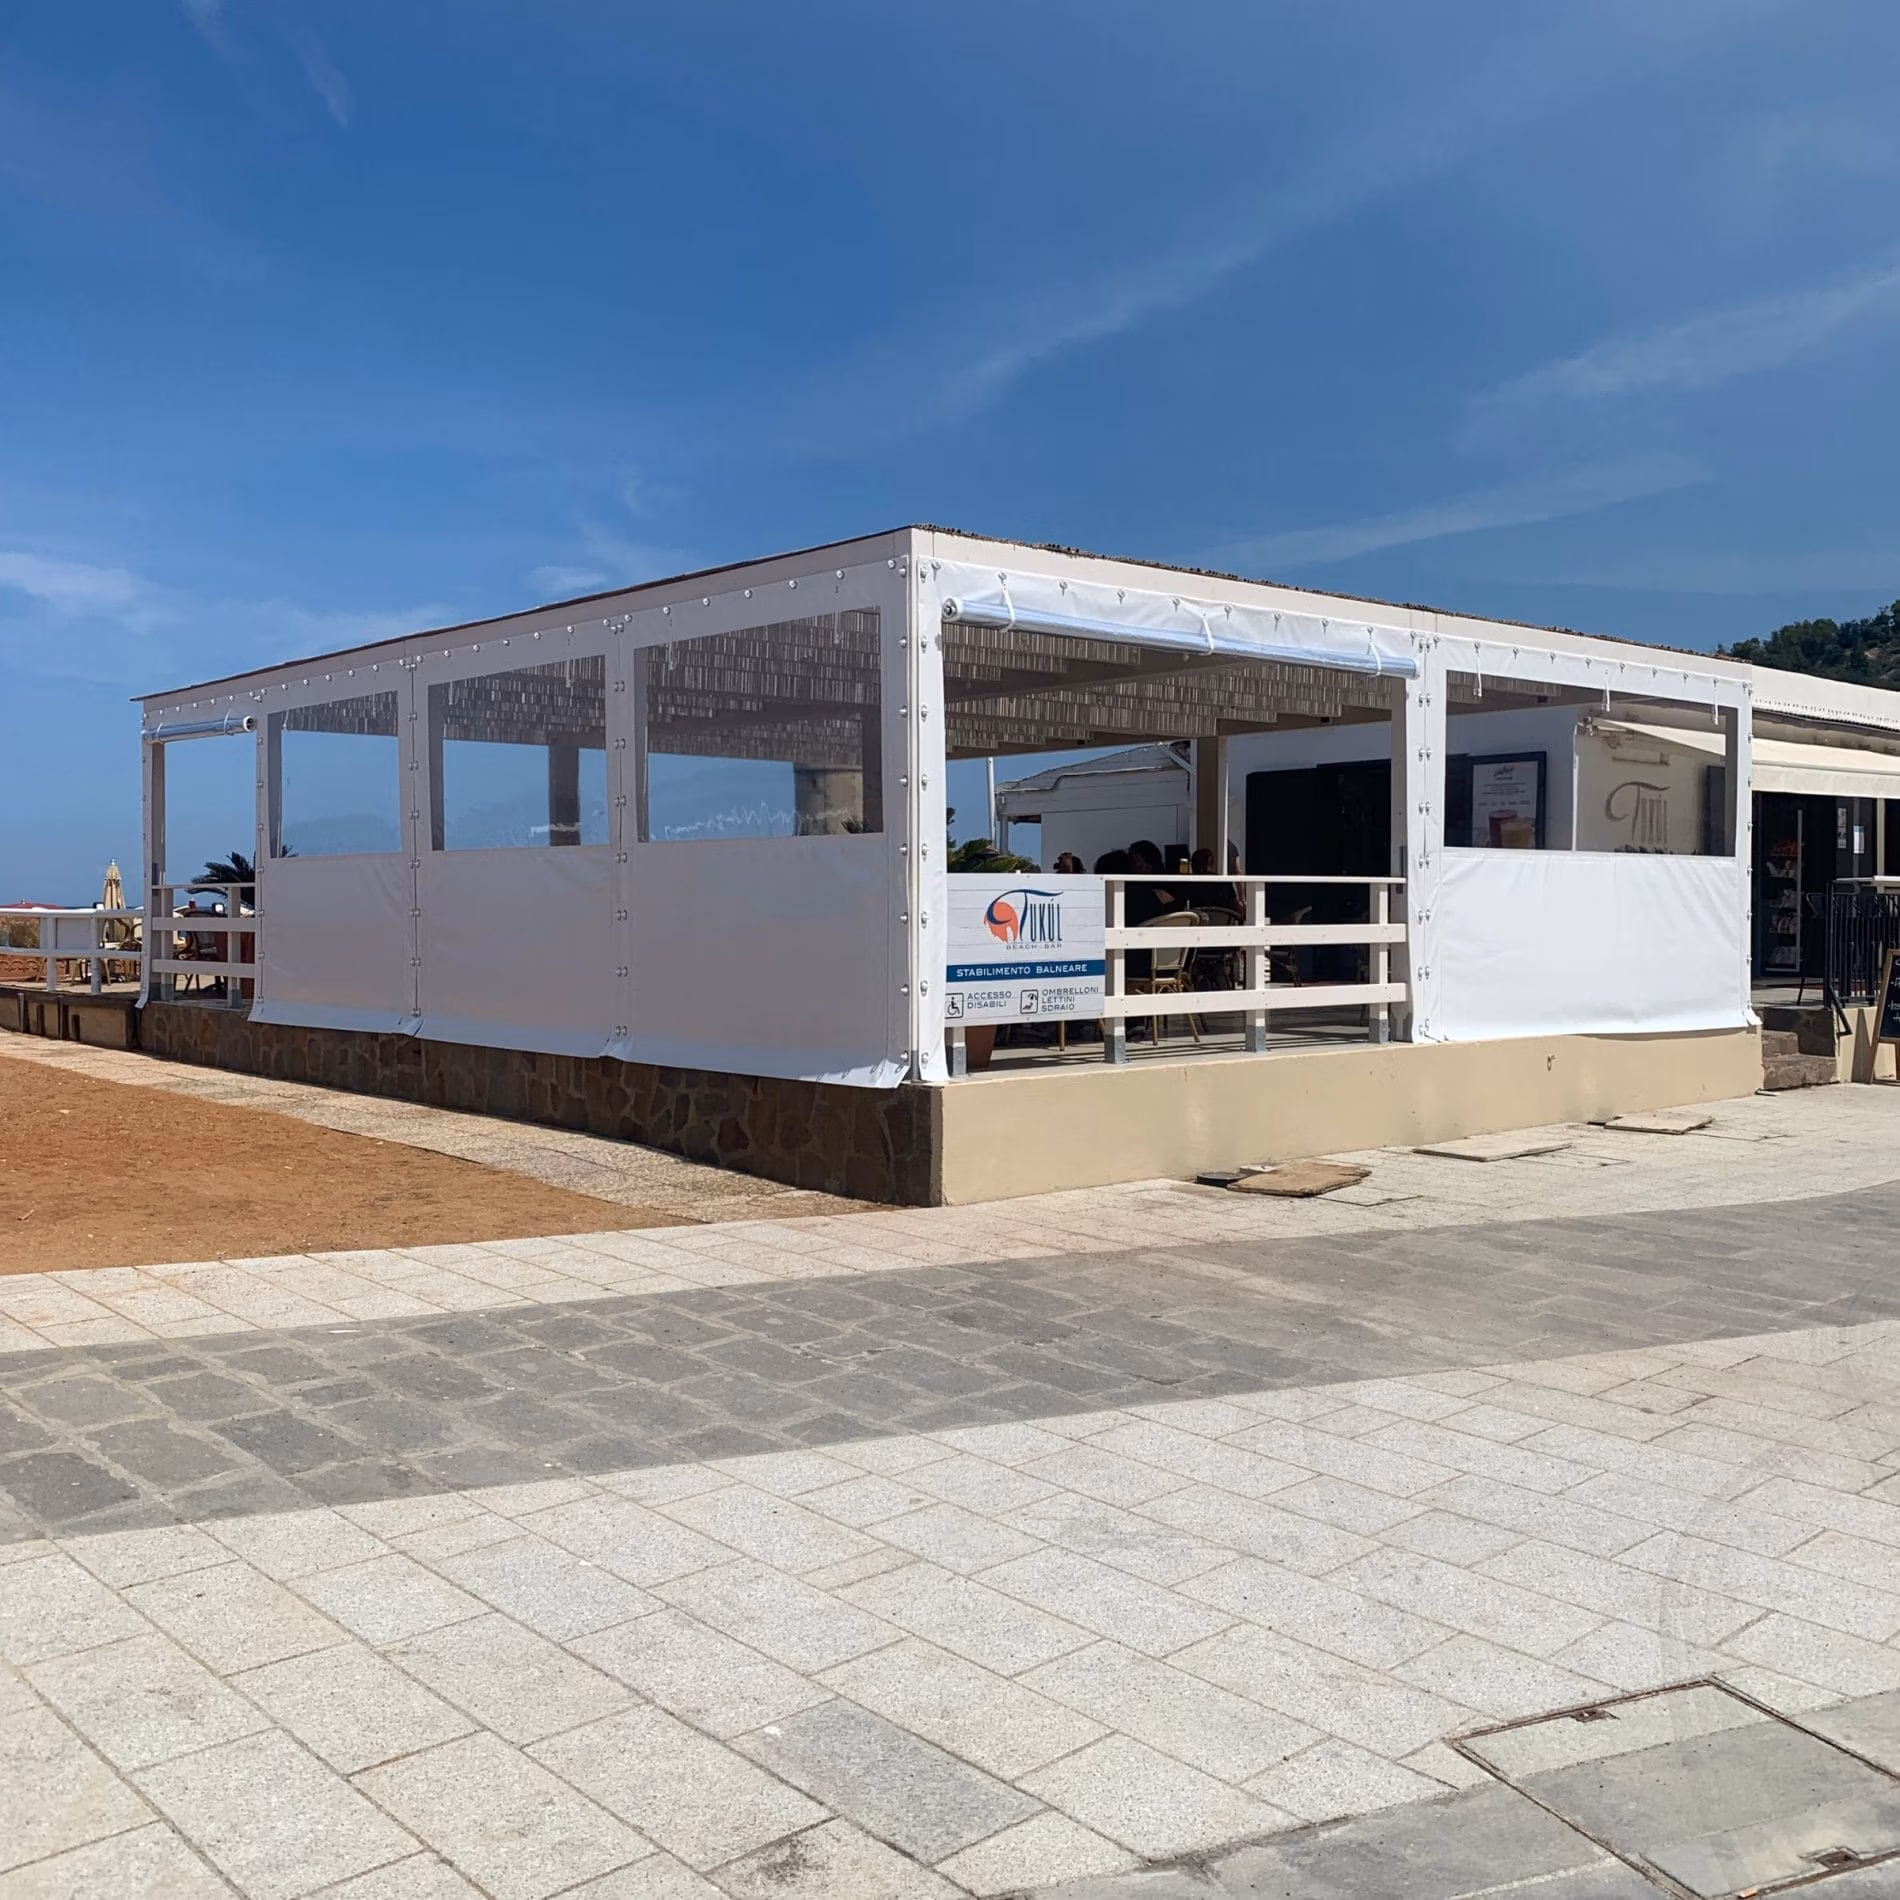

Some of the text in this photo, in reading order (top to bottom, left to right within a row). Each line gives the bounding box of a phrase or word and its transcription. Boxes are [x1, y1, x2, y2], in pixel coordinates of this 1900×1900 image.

[957, 964, 1087, 977] STABILIMENTO BALNEARE
[967, 991, 1012, 1000] ACCESSO
[1042, 987, 1099, 996] OMBRELLONI
[967, 1001, 1007, 1009] DISABILI
[1042, 1004, 1075, 1012] SDRAIO
